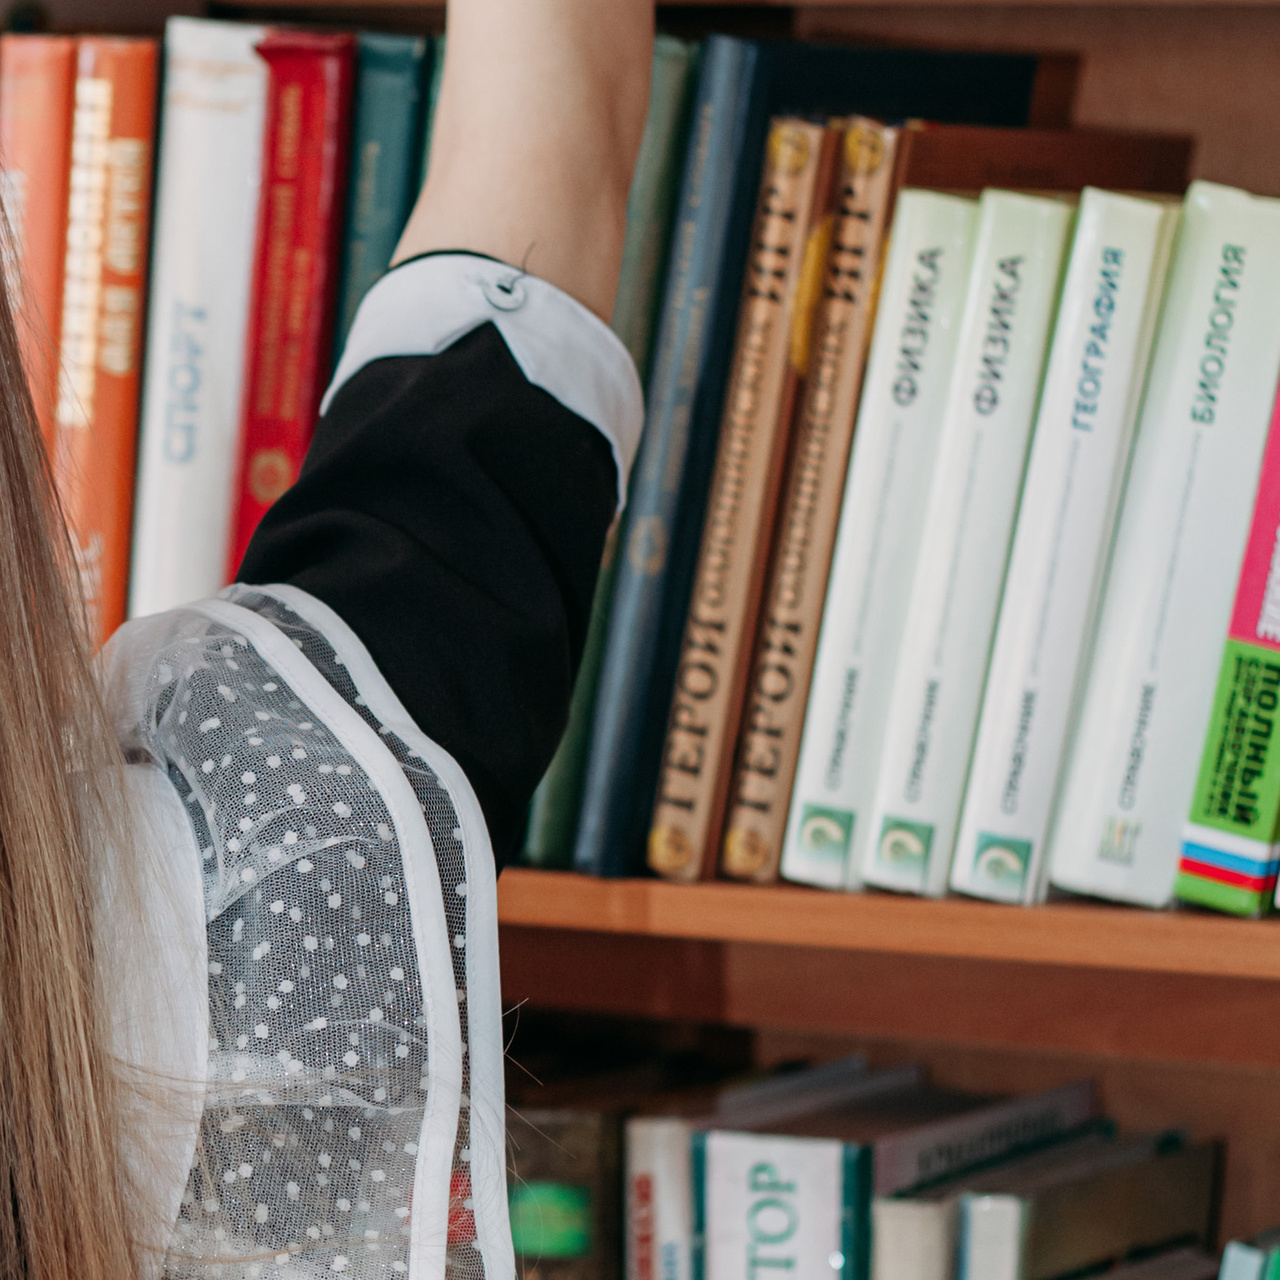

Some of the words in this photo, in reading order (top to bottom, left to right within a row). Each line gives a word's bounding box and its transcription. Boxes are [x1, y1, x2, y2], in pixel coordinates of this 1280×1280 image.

[748, 177, 797, 306] ИГР
[823, 178, 872, 307] ИГР
[163, 294, 208, 464] СПОРТ
[890, 247, 944, 409] ФИЗИКА
[970, 255, 1025, 418] ФИЗИКА
[1070, 246, 1124, 433] ГЕОГРАФИЯ
[1190, 242, 1247, 426] БИОЛОГИЯ
[824, 667, 860, 791] СПРАВОЧНИК
[902, 679, 940, 804] СПРАВОЧНИК
[1000, 689, 1038, 816] СПРАВОЧНИК
[1117, 682, 1156, 812] СПРАВОЧНИК
[1232, 662, 1280, 826] ПОЛНЫЙ
